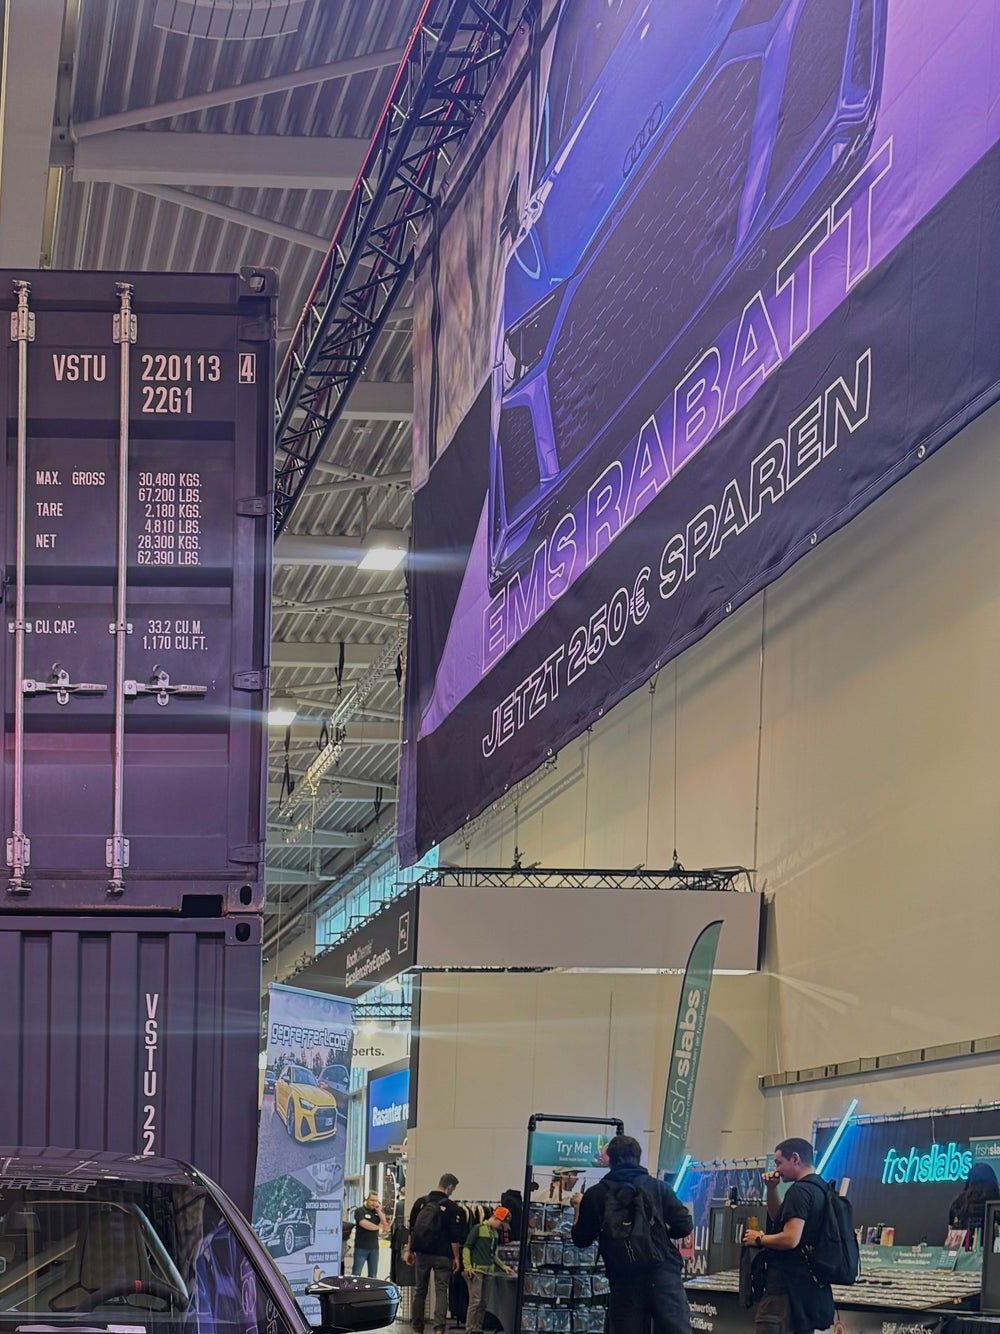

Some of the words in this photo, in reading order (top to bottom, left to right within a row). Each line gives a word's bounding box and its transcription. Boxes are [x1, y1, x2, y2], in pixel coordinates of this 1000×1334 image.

[52, 354, 107, 382] VSTU
[141, 354, 221, 382] 220113
[240, 354, 254, 383] 4
[142, 386, 193, 414] 22G1
[481, 512, 578, 675] EMS
[586, 136, 892, 567] RABATT
[36, 471, 62, 486] MAX.
[72, 471, 106, 486] GROSS
[179, 473, 202, 487] KGS.
[179, 488, 202, 503] LBS.
[36, 502, 64, 517] TARE
[179, 504, 202, 519] KGS.
[178, 519, 202, 534] LBS.
[36, 534, 57, 548] NET
[178, 535, 201, 550] KGS.
[178, 551, 201, 565] LBS.
[482, 645, 565, 758] JETZT
[567, 566, 651, 687] 250€
[659, 347, 872, 600] SPAREN
[148, 620, 171, 634] 33.2
[143, 993, 159, 1097] VSTU
[665, 988, 700, 1141] frshslabs
[556, 1140, 572, 1156] Try
[574, 1141, 592, 1154] Me!
[881, 1143, 973, 1184] frshslabs
